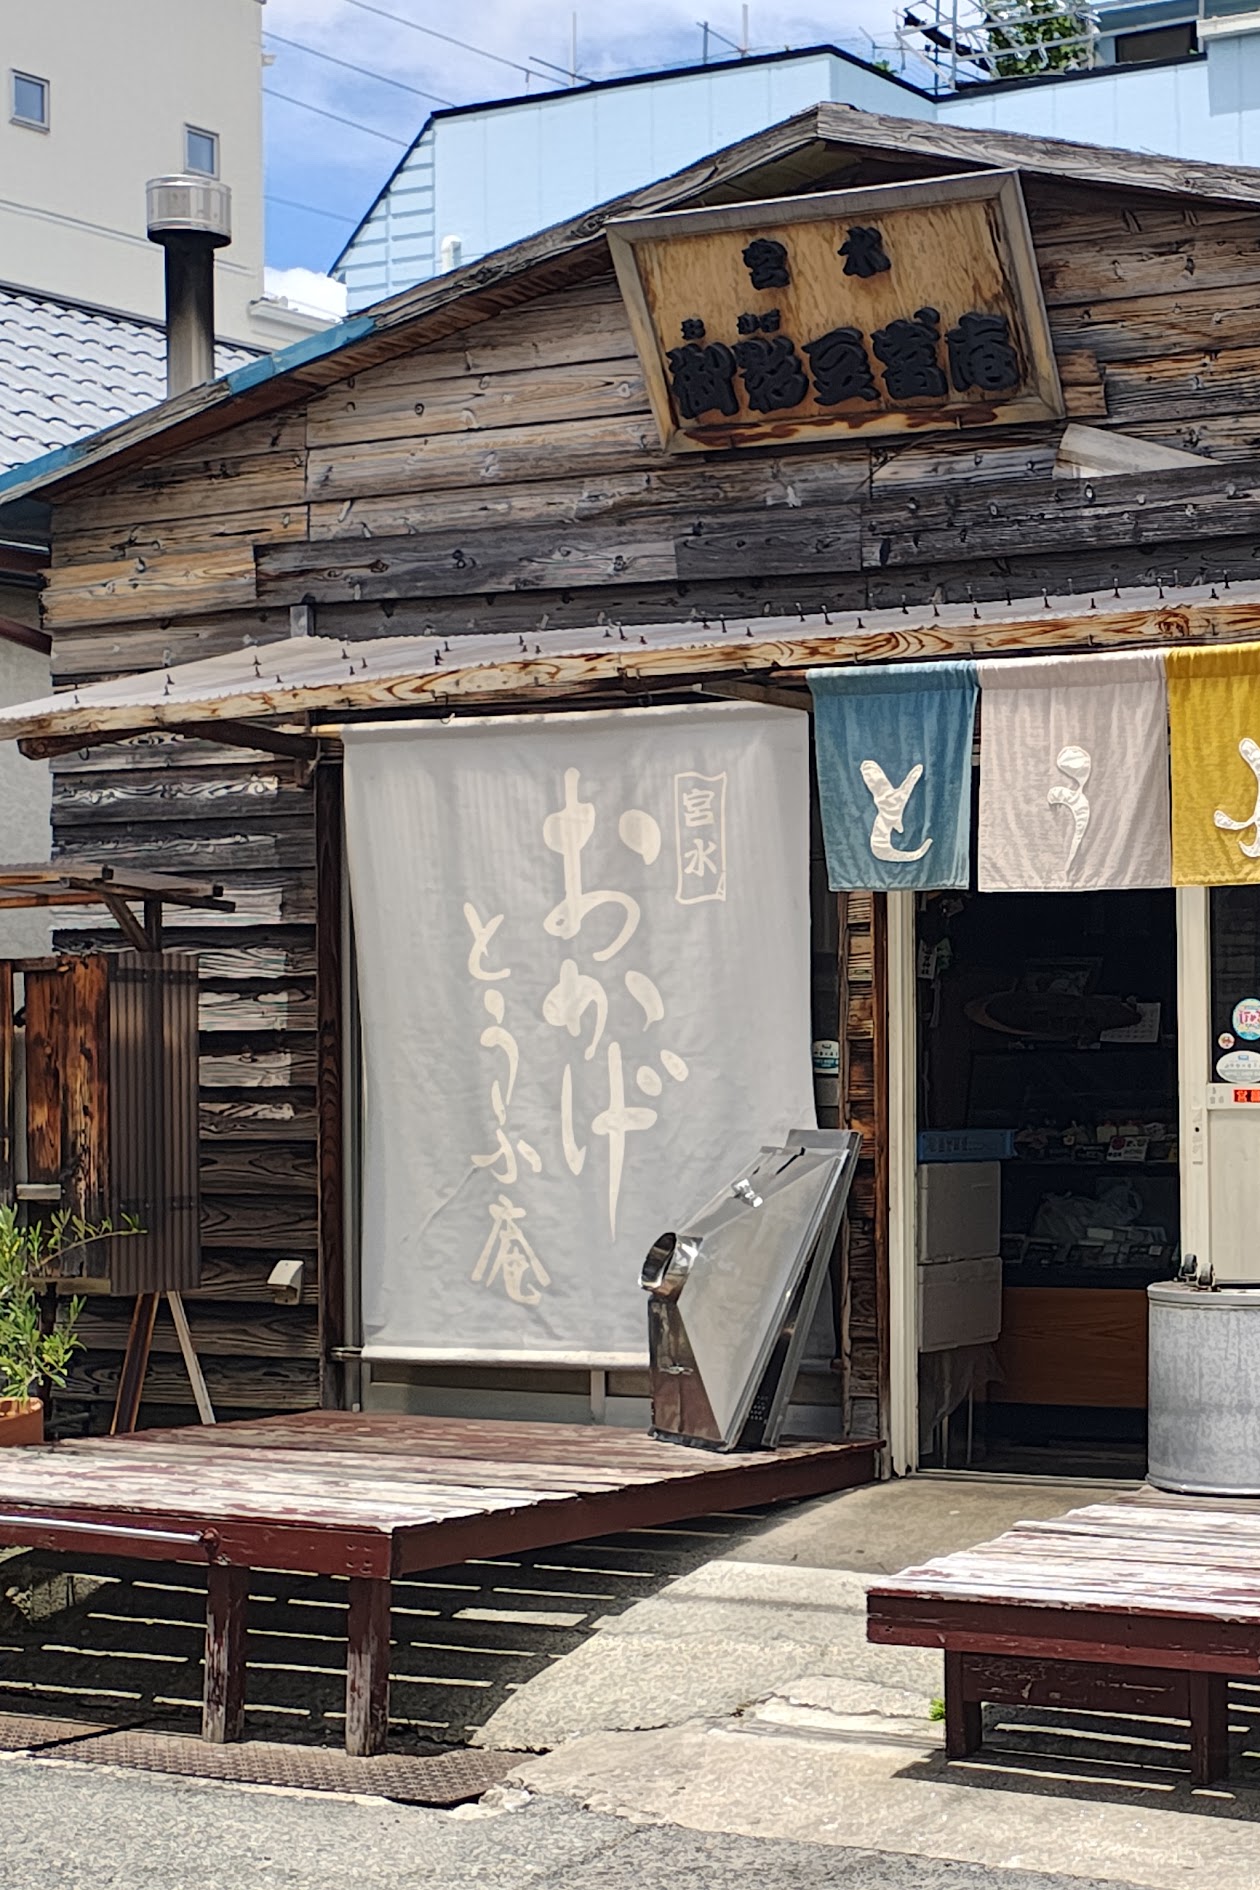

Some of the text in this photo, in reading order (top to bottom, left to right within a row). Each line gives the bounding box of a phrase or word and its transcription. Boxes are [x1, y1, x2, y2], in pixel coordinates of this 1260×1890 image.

[541, 766, 690, 1242] おかげ
[682, 788, 720, 878] 宮水
[462, 901, 551, 1305] とうふ庵
